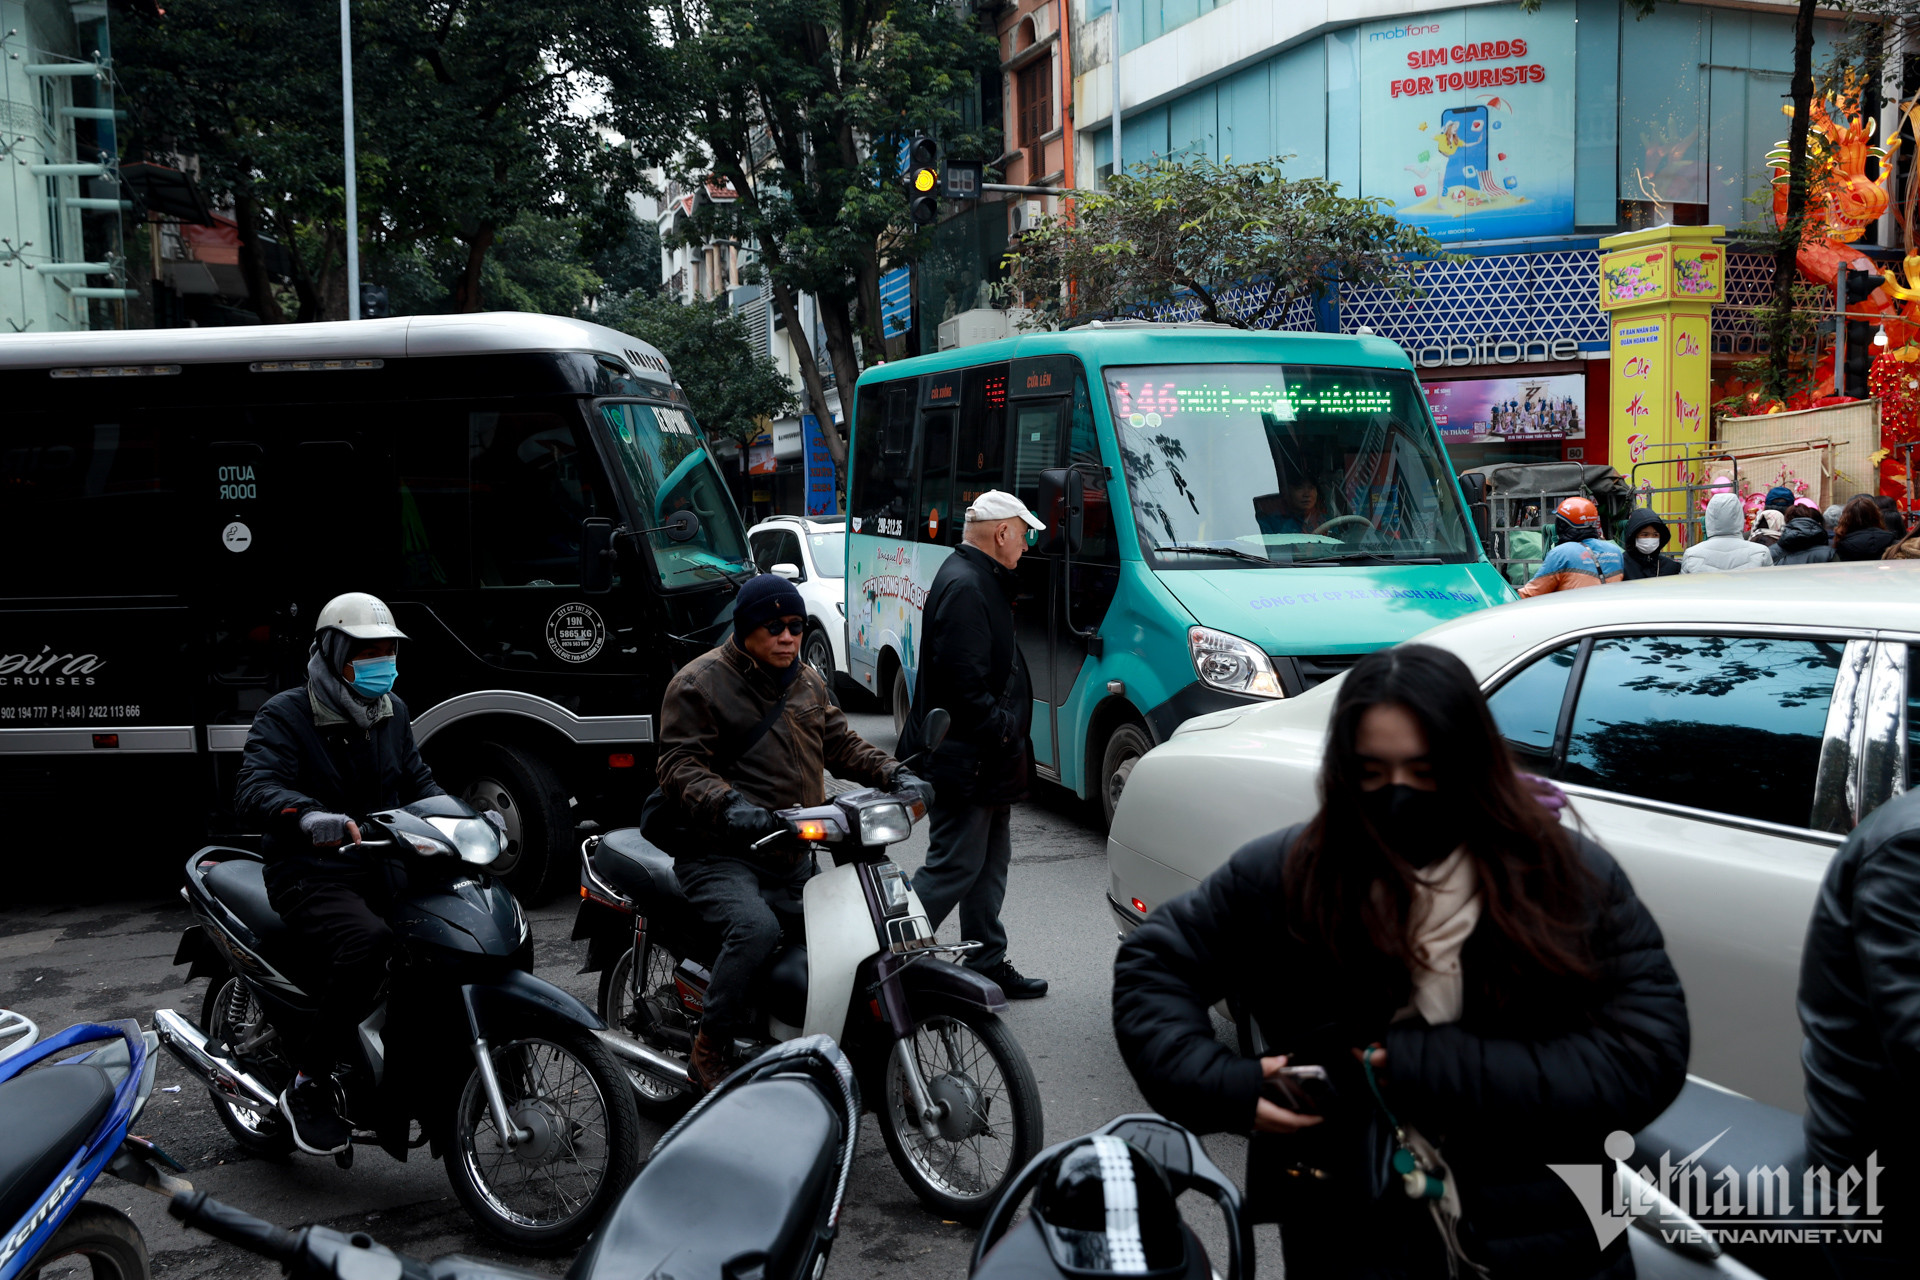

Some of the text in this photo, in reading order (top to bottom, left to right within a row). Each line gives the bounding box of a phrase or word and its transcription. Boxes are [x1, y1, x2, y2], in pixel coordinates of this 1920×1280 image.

[1369, 24, 1440, 42] mobifone
[1407, 38, 1528, 69] SIM CARDS
[1390, 64, 1546, 98] FOR TOURISTS
[1569, 448, 1582, 458] 80
[1250, 587, 1480, 610] CÔNG TY CP XE KHÁCH HÀ NỘI
[580, 629, 592, 638] KG
[0, 677, 96, 686] CRUISES
[18, 707, 32, 719] 194
[33, 706, 48, 719] 777
[88, 706, 108, 718] 2422
[110, 706, 124, 717] 113
[125, 705, 140, 717] 666
